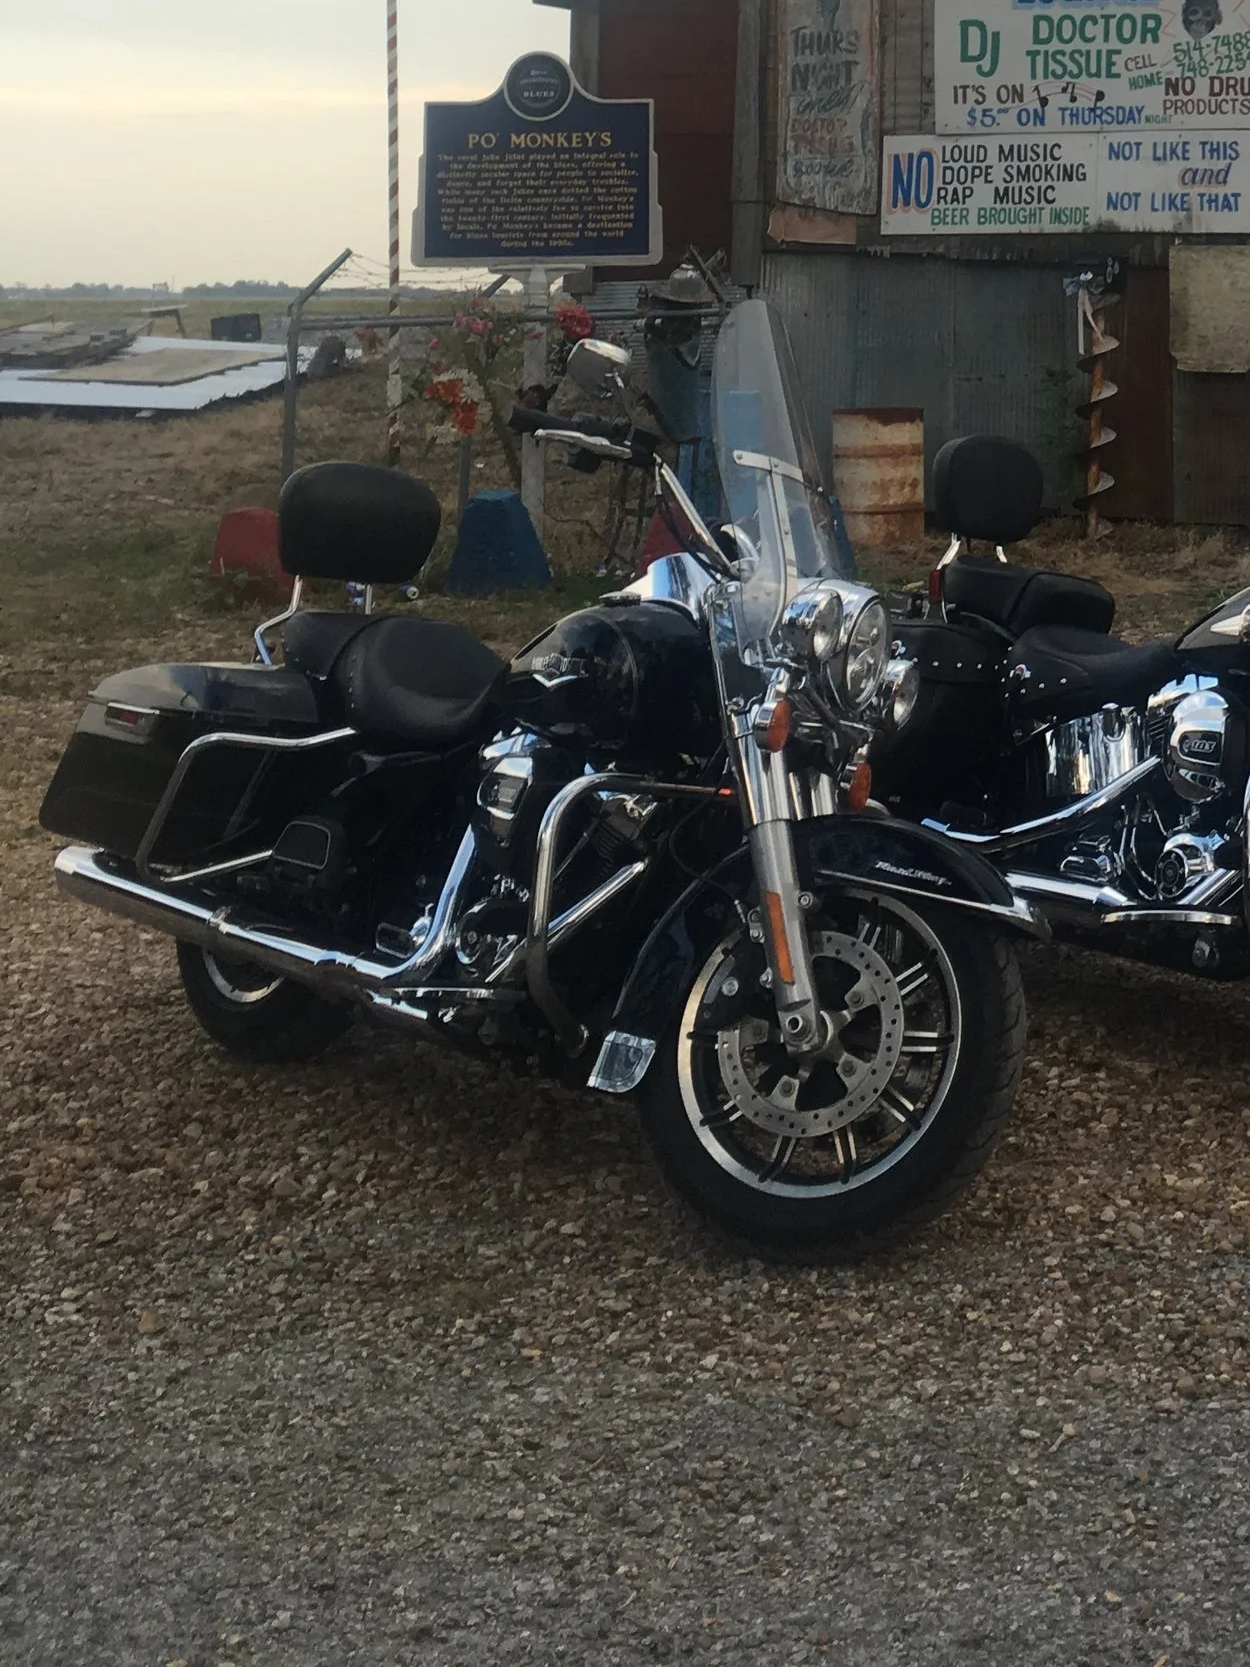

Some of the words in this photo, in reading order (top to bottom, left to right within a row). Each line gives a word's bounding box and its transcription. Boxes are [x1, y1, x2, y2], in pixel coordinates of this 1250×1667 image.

[959, 19, 1000, 78] DJ
[1032, 13, 1162, 46] DOCTOR
[1026, 49, 1122, 80] TISSUE
[1124, 54, 1157, 72] CELL
[1128, 71, 1163, 91] HOME
[1164, 76, 1196, 97] NO
[953, 84, 987, 106] IT'S
[996, 83, 1024, 104] ON
[1016, 107, 1045, 127] ON
[1058, 106, 1145, 125] THURSDAY
[510, 131, 612, 148] MONKEY'S
[942, 144, 988, 164] LOUD
[998, 142, 1062, 163] MUSIC
[1108, 141, 1144, 161] NOT
[1152, 140, 1190, 161] LIKE
[1199, 140, 1240, 161] THIS
[891, 150, 935, 209] NO
[942, 165, 994, 185] DOPE
[1002, 162, 1088, 183] SMOKING
[1179, 163, 1232, 186] and
[936, 186, 974, 206] RAP
[993, 185, 1057, 205] MUSIC
[1105, 192, 1141, 212] NOT
[1150, 192, 1189, 212] LIKE
[1197, 192, 1241, 212] THAT
[930, 208, 969, 226] BEER
[977, 207, 1046, 226] BROUGHT
[1049, 206, 1090, 226] INSIDE
